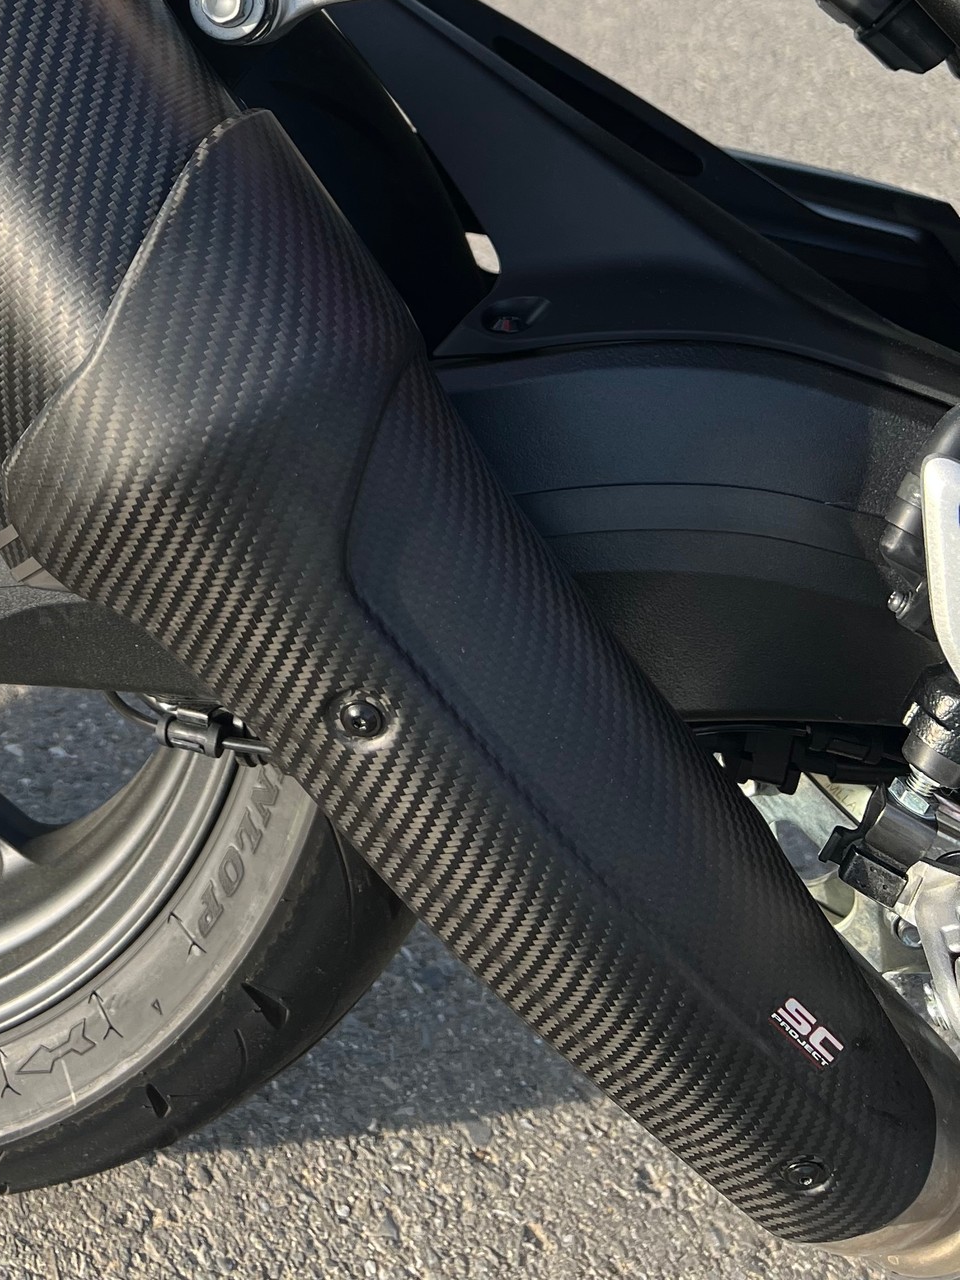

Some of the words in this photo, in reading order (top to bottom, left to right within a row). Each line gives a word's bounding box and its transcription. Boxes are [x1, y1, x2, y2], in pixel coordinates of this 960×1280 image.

[198, 763, 284, 938] NLOP
[770, 1012, 829, 1066] PROJECT
[776, 997, 844, 1063] SC
